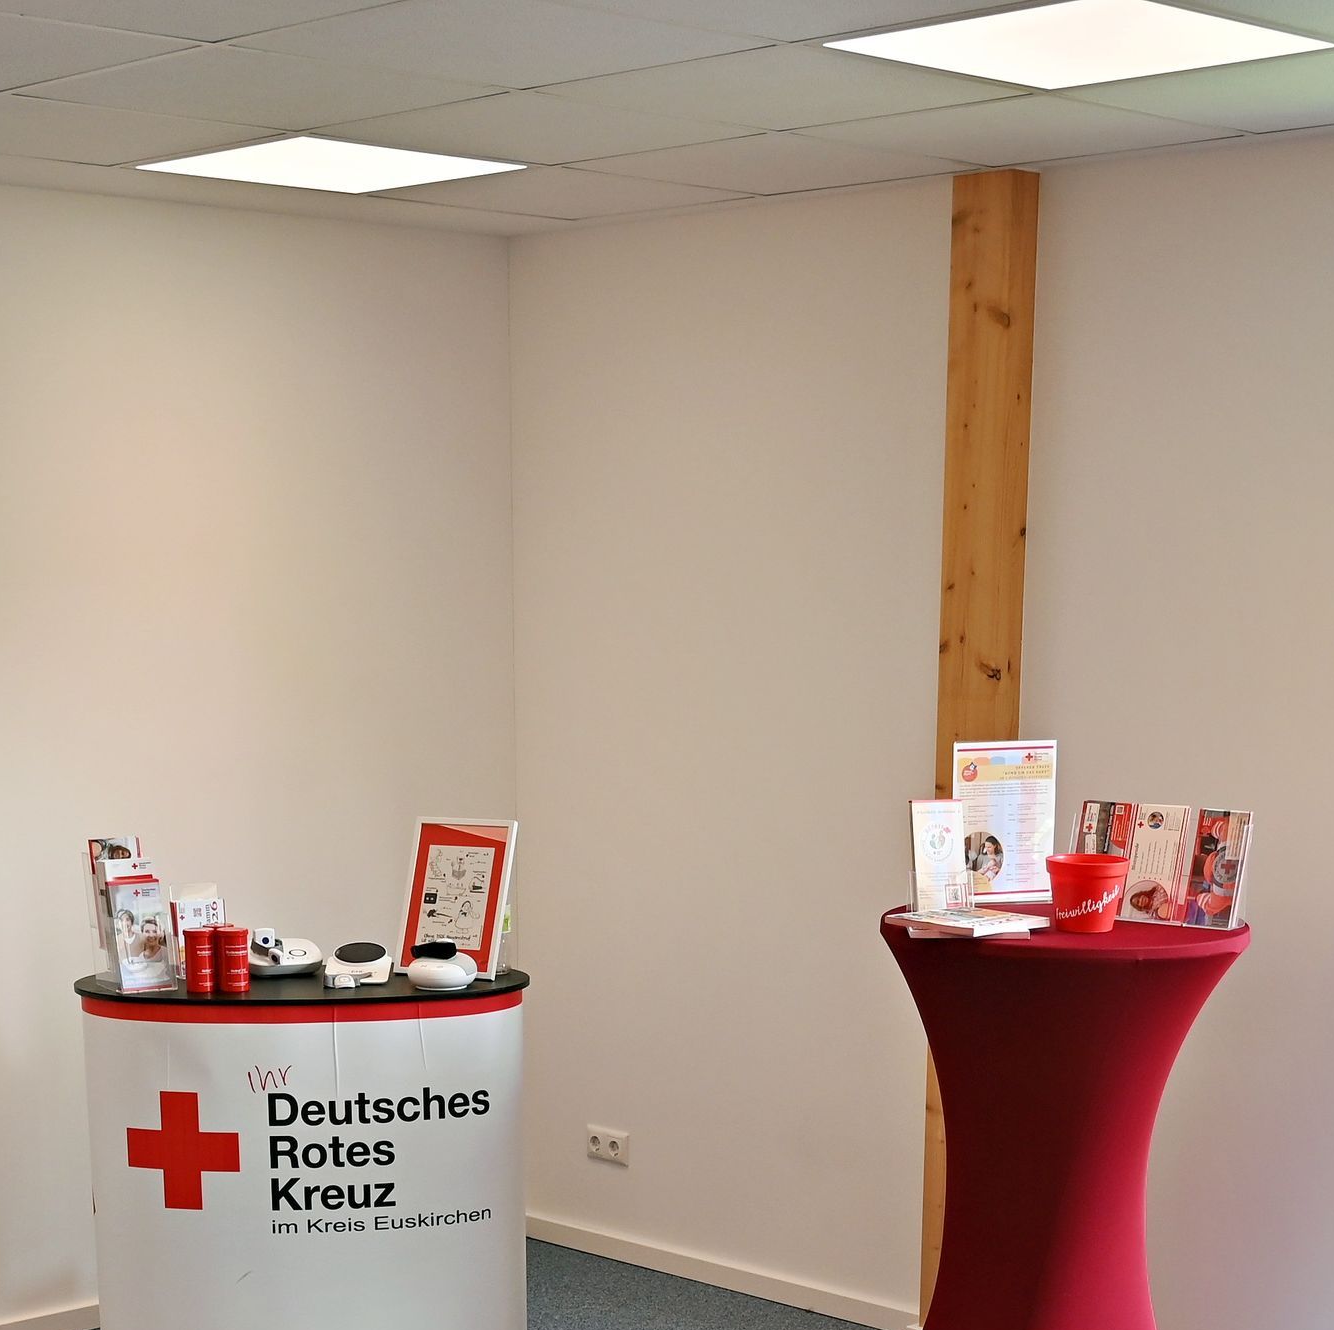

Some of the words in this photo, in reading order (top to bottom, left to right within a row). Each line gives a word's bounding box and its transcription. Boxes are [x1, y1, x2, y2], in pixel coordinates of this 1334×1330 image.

[247, 1064, 292, 1093] Ihr
[267, 1086, 491, 1127] Deutsches
[268, 1134, 397, 1170] Rotes
[269, 1176, 397, 1212] Kreuz
[271, 1218, 299, 1235] im
[306, 1216, 366, 1234] Kreis
[373, 1207, 493, 1232] Euskirchen
